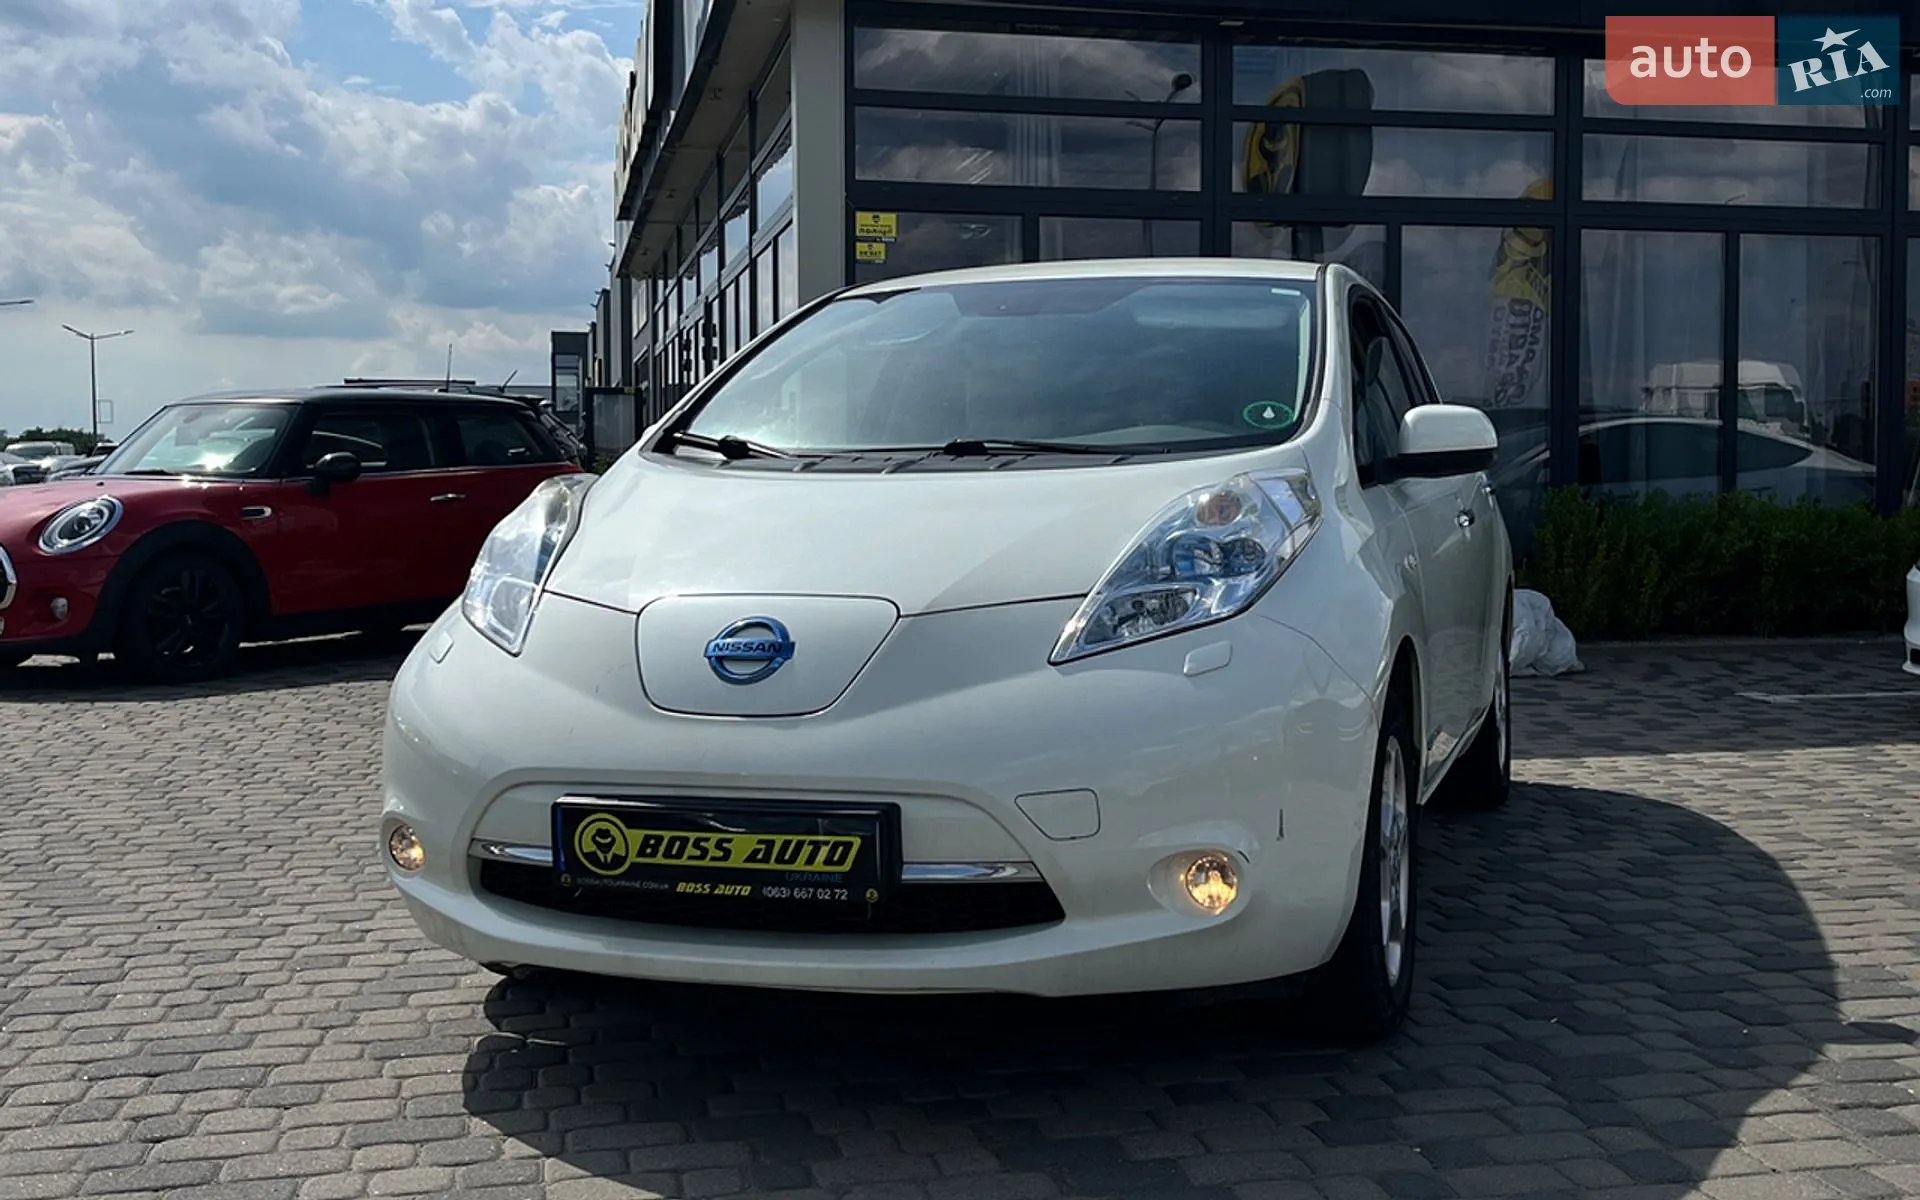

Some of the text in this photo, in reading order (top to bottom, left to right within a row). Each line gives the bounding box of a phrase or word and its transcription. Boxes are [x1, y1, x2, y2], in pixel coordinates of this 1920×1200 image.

[711, 641, 783, 654] NISSAN
[635, 834, 854, 866] BOSS AUTO
[675, 882, 752, 896] BOSS AUTO
[762, 886, 848, 901] (063) 667 02 72
